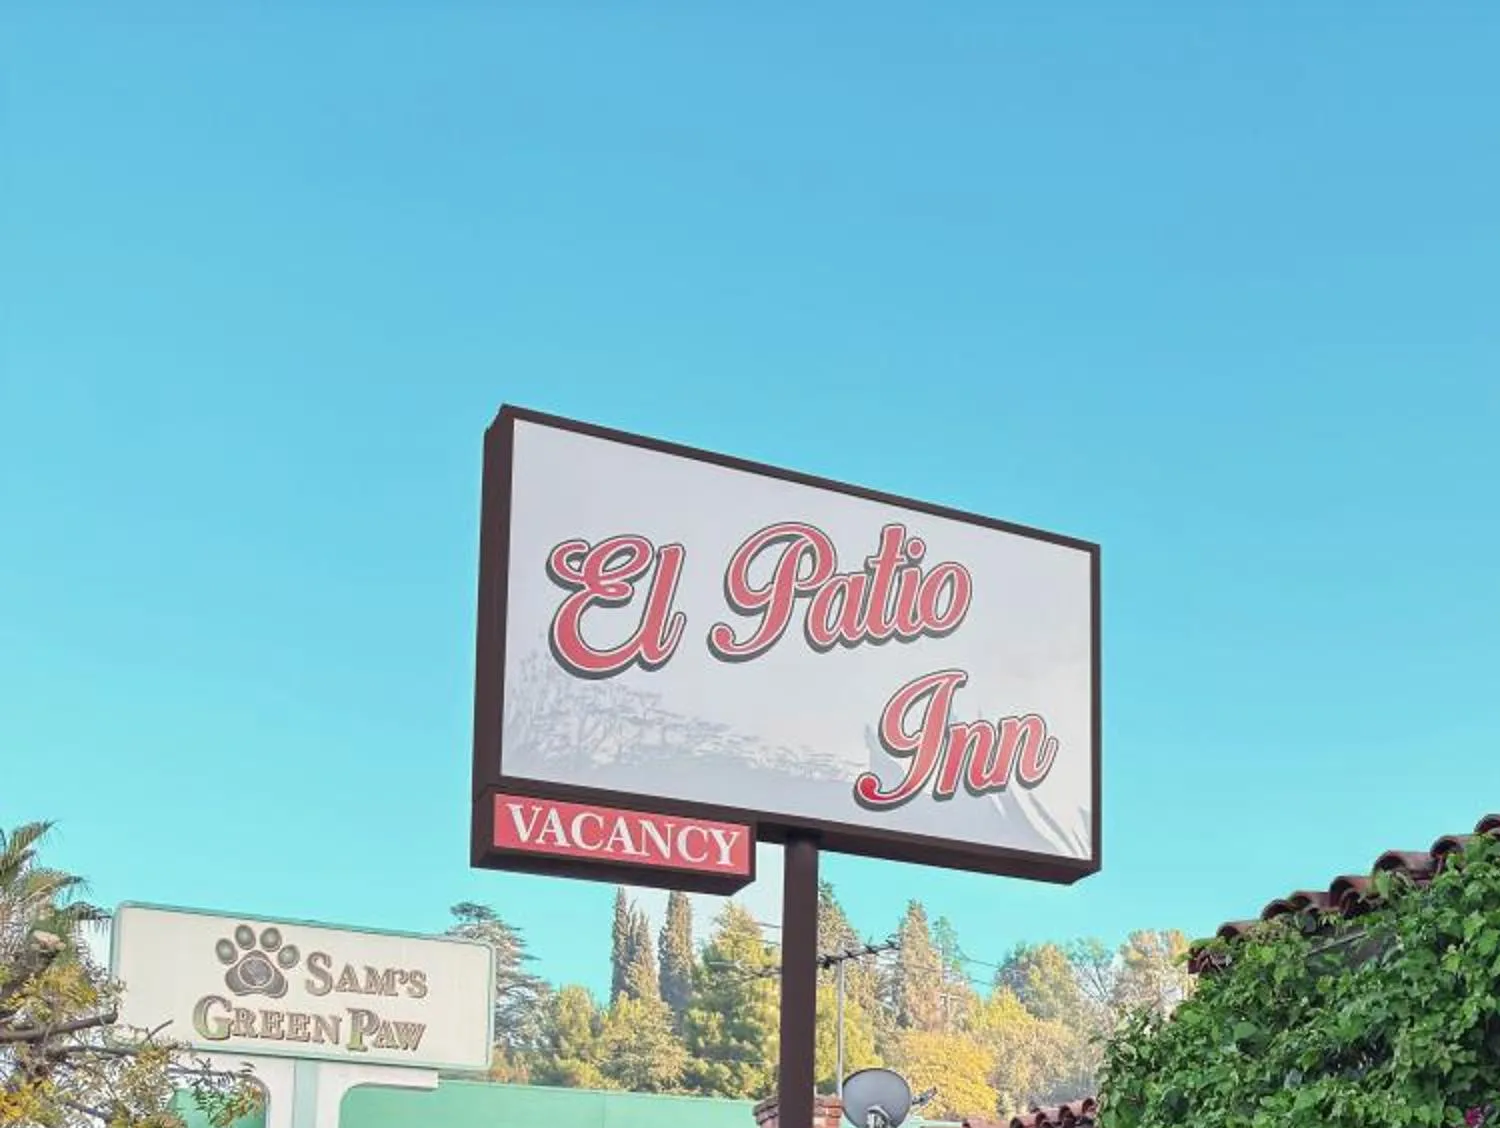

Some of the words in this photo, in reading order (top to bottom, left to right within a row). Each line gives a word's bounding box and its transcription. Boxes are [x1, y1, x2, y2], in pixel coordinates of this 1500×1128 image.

[545, 535, 687, 679] El
[707, 521, 973, 663] Patio
[853, 669, 1059, 810] Inn
[505, 802, 742, 867] VACANCY
[304, 950, 429, 999] SAM'S
[192, 995, 343, 1045] GREEN
[345, 1007, 428, 1052] PAW
